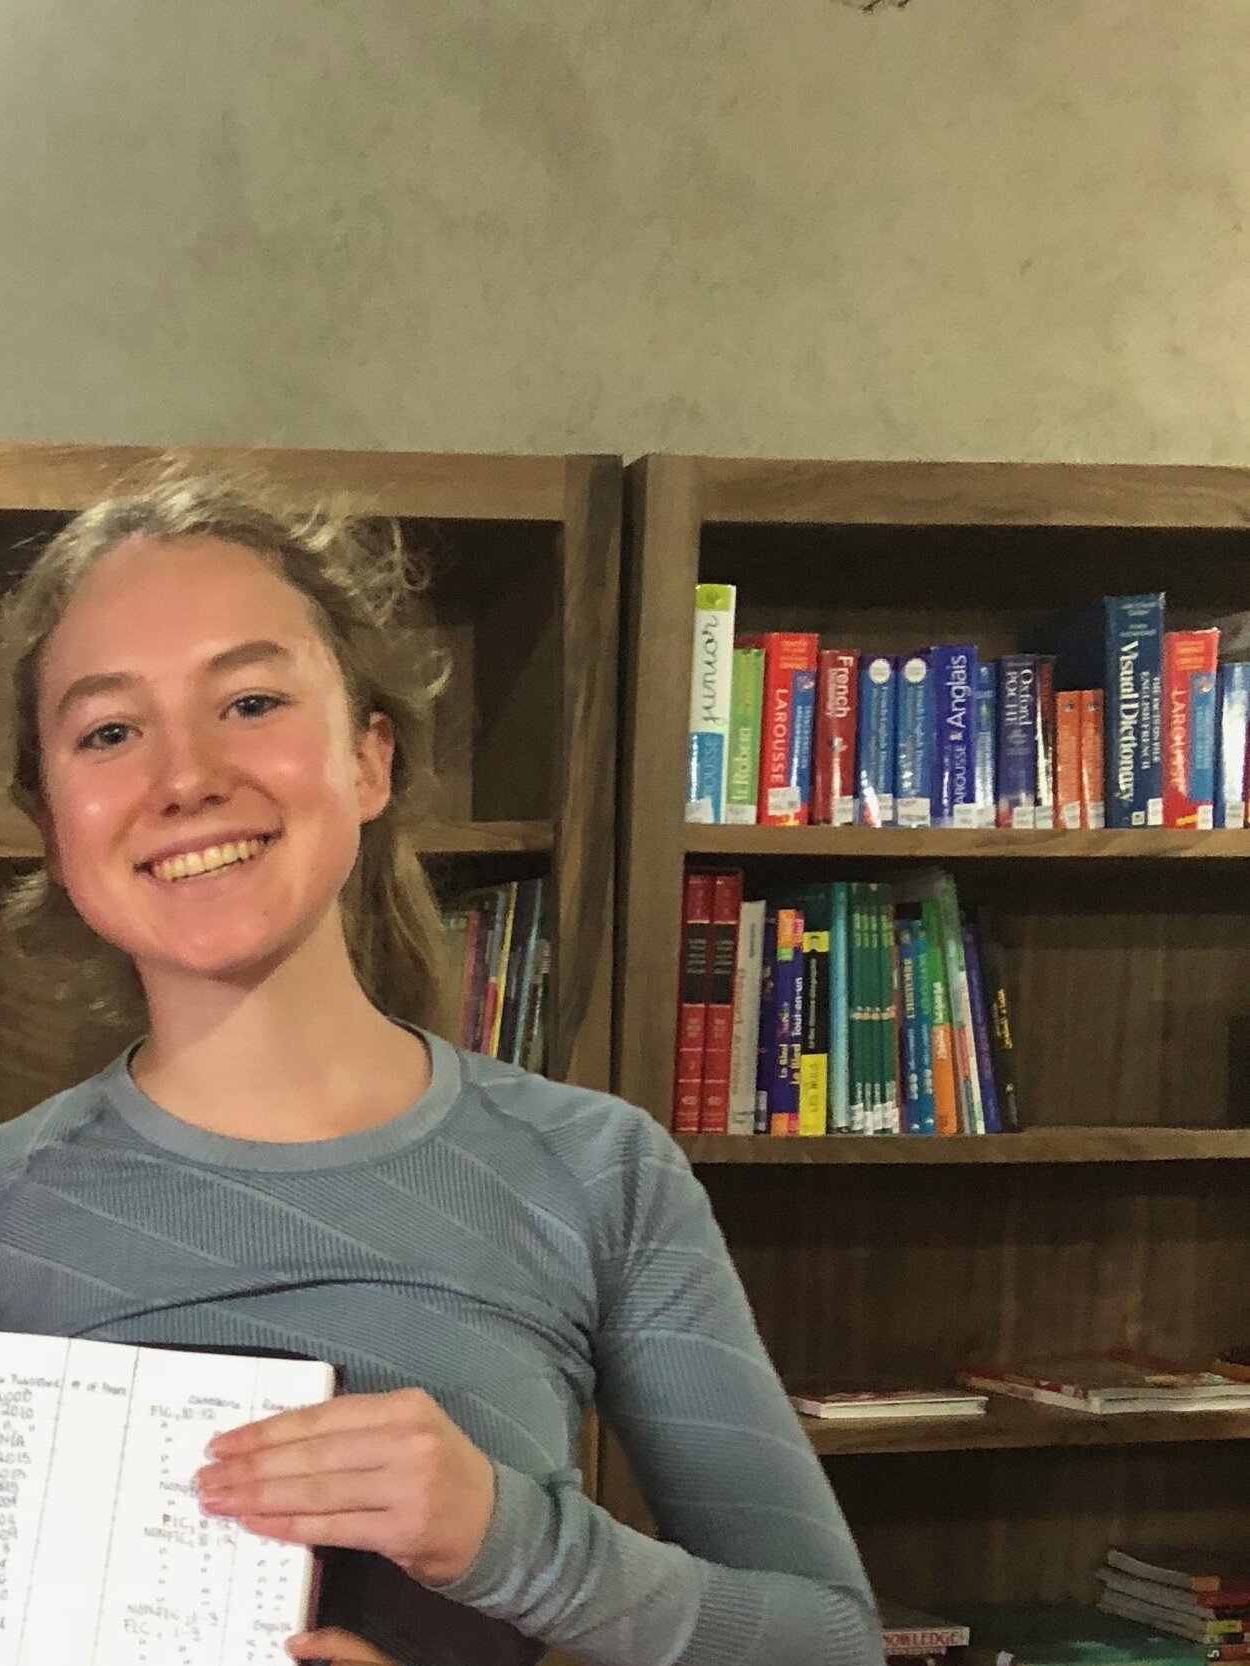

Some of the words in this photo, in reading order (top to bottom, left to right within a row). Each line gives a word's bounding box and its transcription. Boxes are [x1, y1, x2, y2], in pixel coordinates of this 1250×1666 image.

[836, 655, 852, 719] French
[945, 653, 972, 729] Anglais
[1018, 668, 1034, 726] Oxford
[1119, 640, 1139, 699] Visual
[771, 686, 790, 784] LAROUSSE
[1116, 702, 1139, 803] Dictionary
[953, 744, 968, 804] AROUSSE
